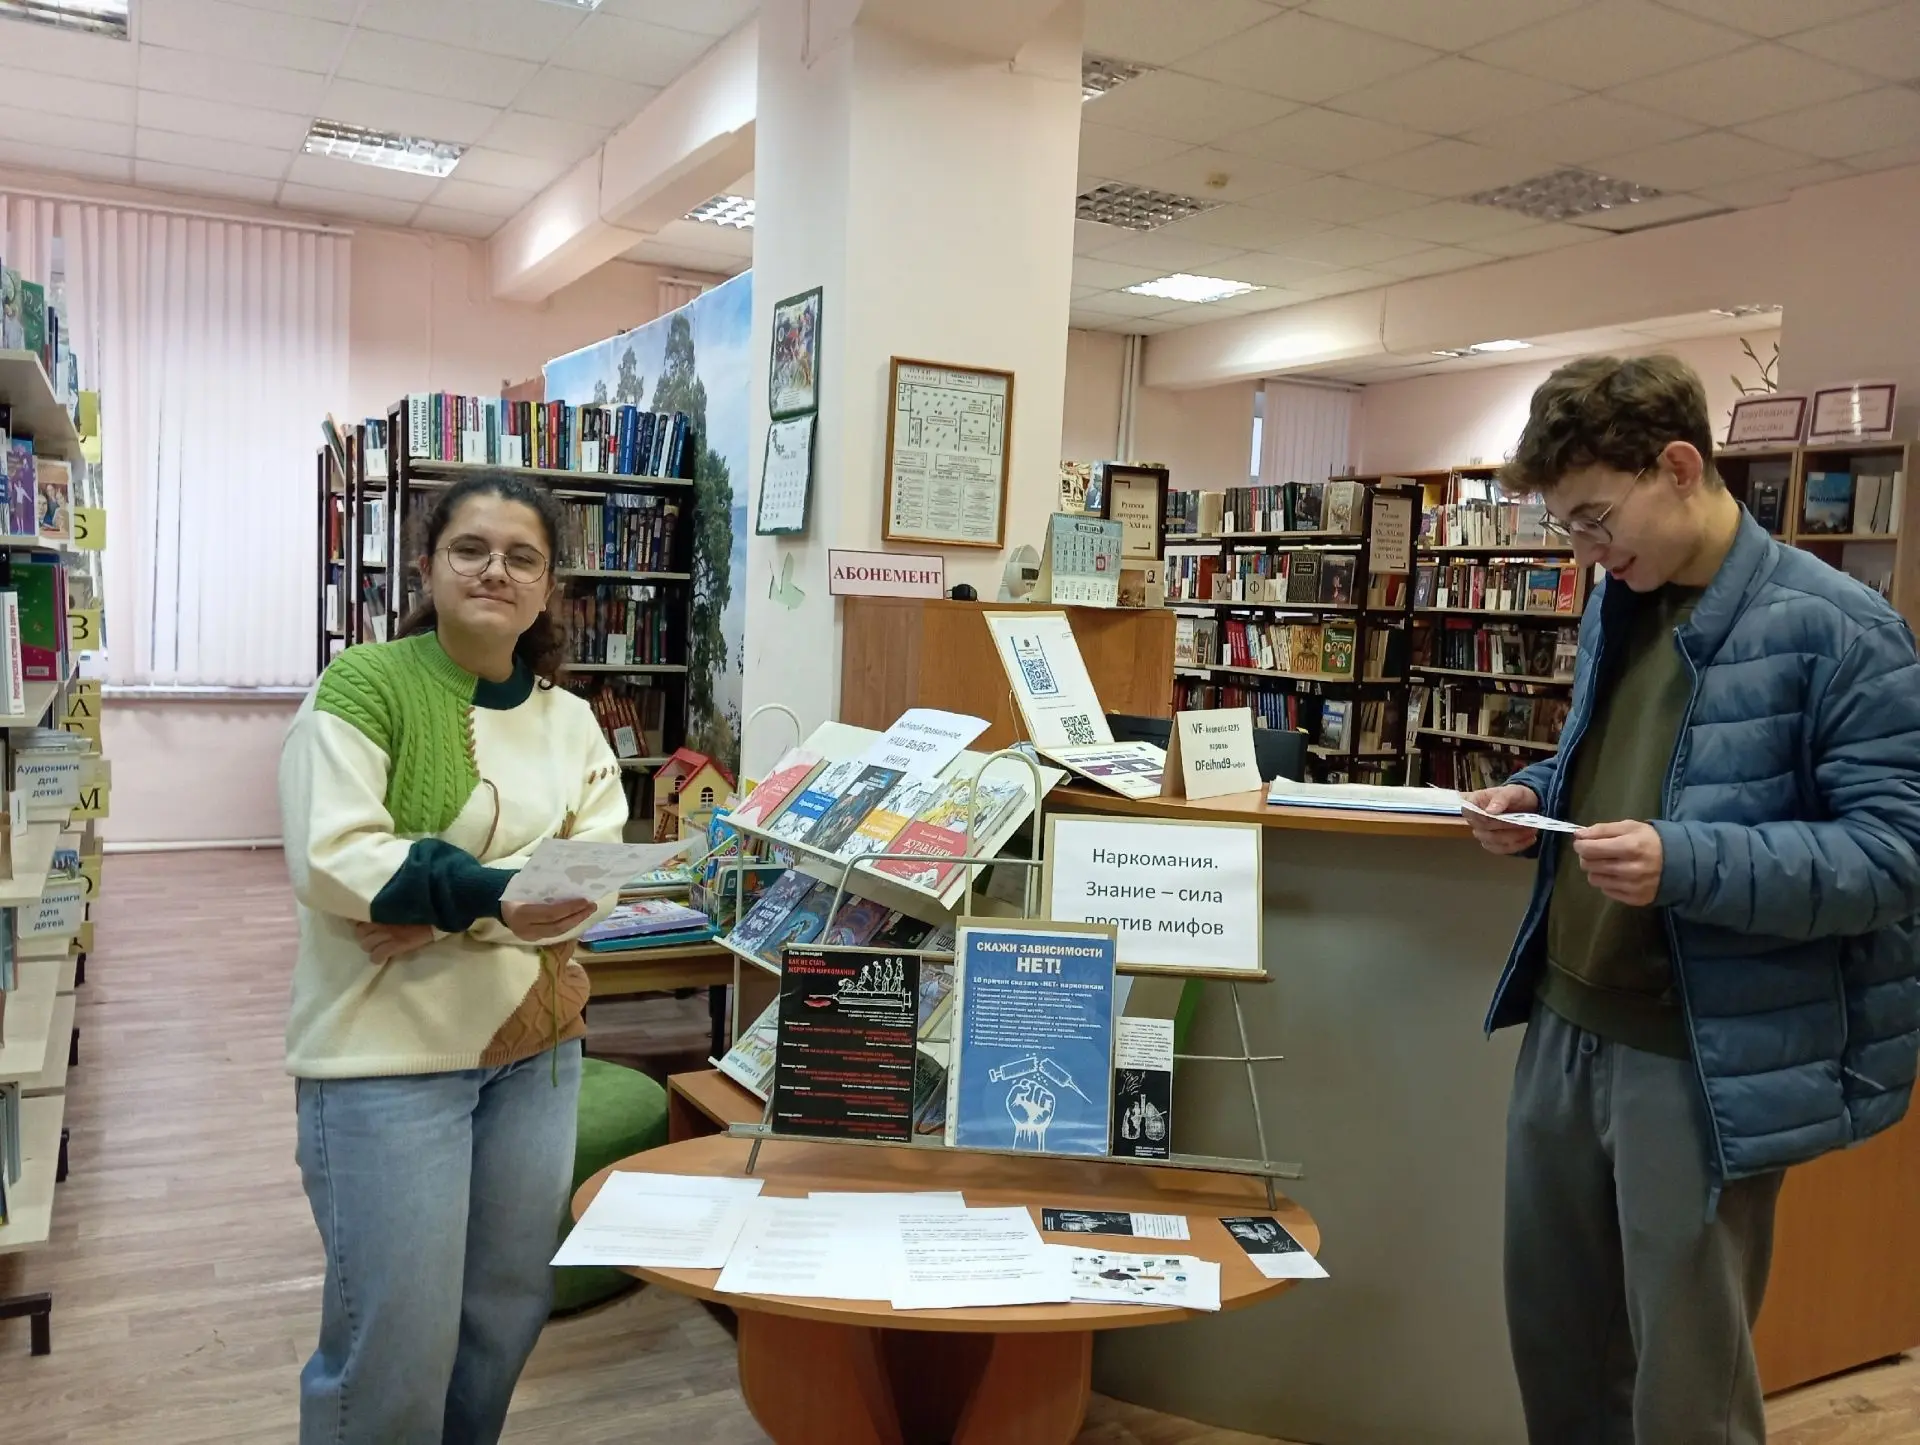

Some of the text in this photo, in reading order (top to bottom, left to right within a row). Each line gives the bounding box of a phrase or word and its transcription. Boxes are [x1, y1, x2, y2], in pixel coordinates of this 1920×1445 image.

[833, 565, 941, 584] АБОНЕМЕНТ
[1249, 580, 1260, 594] Ф
[887, 737, 905, 748] НАШ
[904, 740, 932, 753] ВЫБОР
[882, 754, 911, 768] КНИГА
[17, 763, 80, 774] Аудиокниги
[37, 777, 59, 785] для
[32, 789, 63, 798] детей
[1092, 848, 1219, 869] Наркомания.
[1086, 881, 1156, 899] Знание
[1178, 888, 1223, 903] сила
[39, 909, 60, 918] для
[33, 920, 65, 931] детей
[1158, 917, 1224, 938] мифов
[976, 941, 1104, 958] СКАЖИ ЗАВИСИМОСТИ
[1016, 957, 1062, 975] НЕТ!
[982, 978, 1010, 986] причин
[1010, 979, 1039, 987] сказать
[1060, 982, 1104, 991] наркотикам
